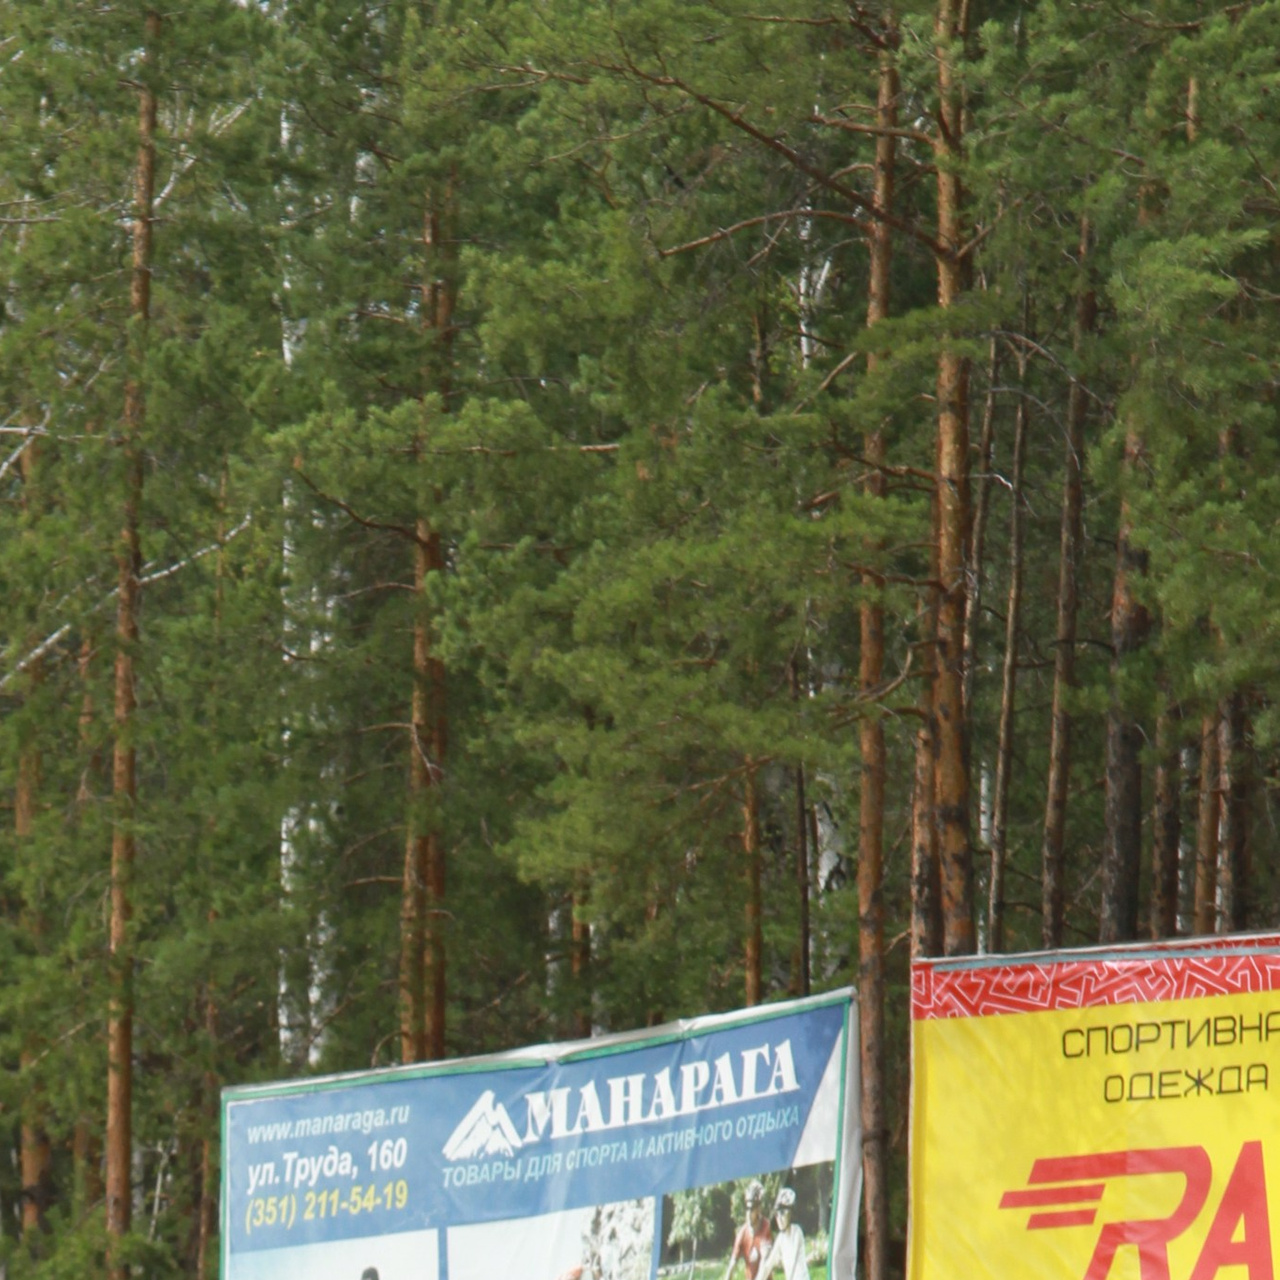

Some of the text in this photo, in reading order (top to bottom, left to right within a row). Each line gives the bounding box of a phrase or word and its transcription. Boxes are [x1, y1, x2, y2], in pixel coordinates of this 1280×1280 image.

[523, 1038, 801, 1143] МАНАРАГА
[1104, 1063, 1268, 1103] ОДЕЖДА
[247, 1105, 410, 1144] www.manaraga.ru
[442, 1105, 799, 1187] ТОВАРЫ ДЛЯ СПОРТА И АКТИВНОГО ОТДЫХА
[368, 1137, 408, 1172] 160
[245, 1179, 408, 1236] (351) 211-54-19
